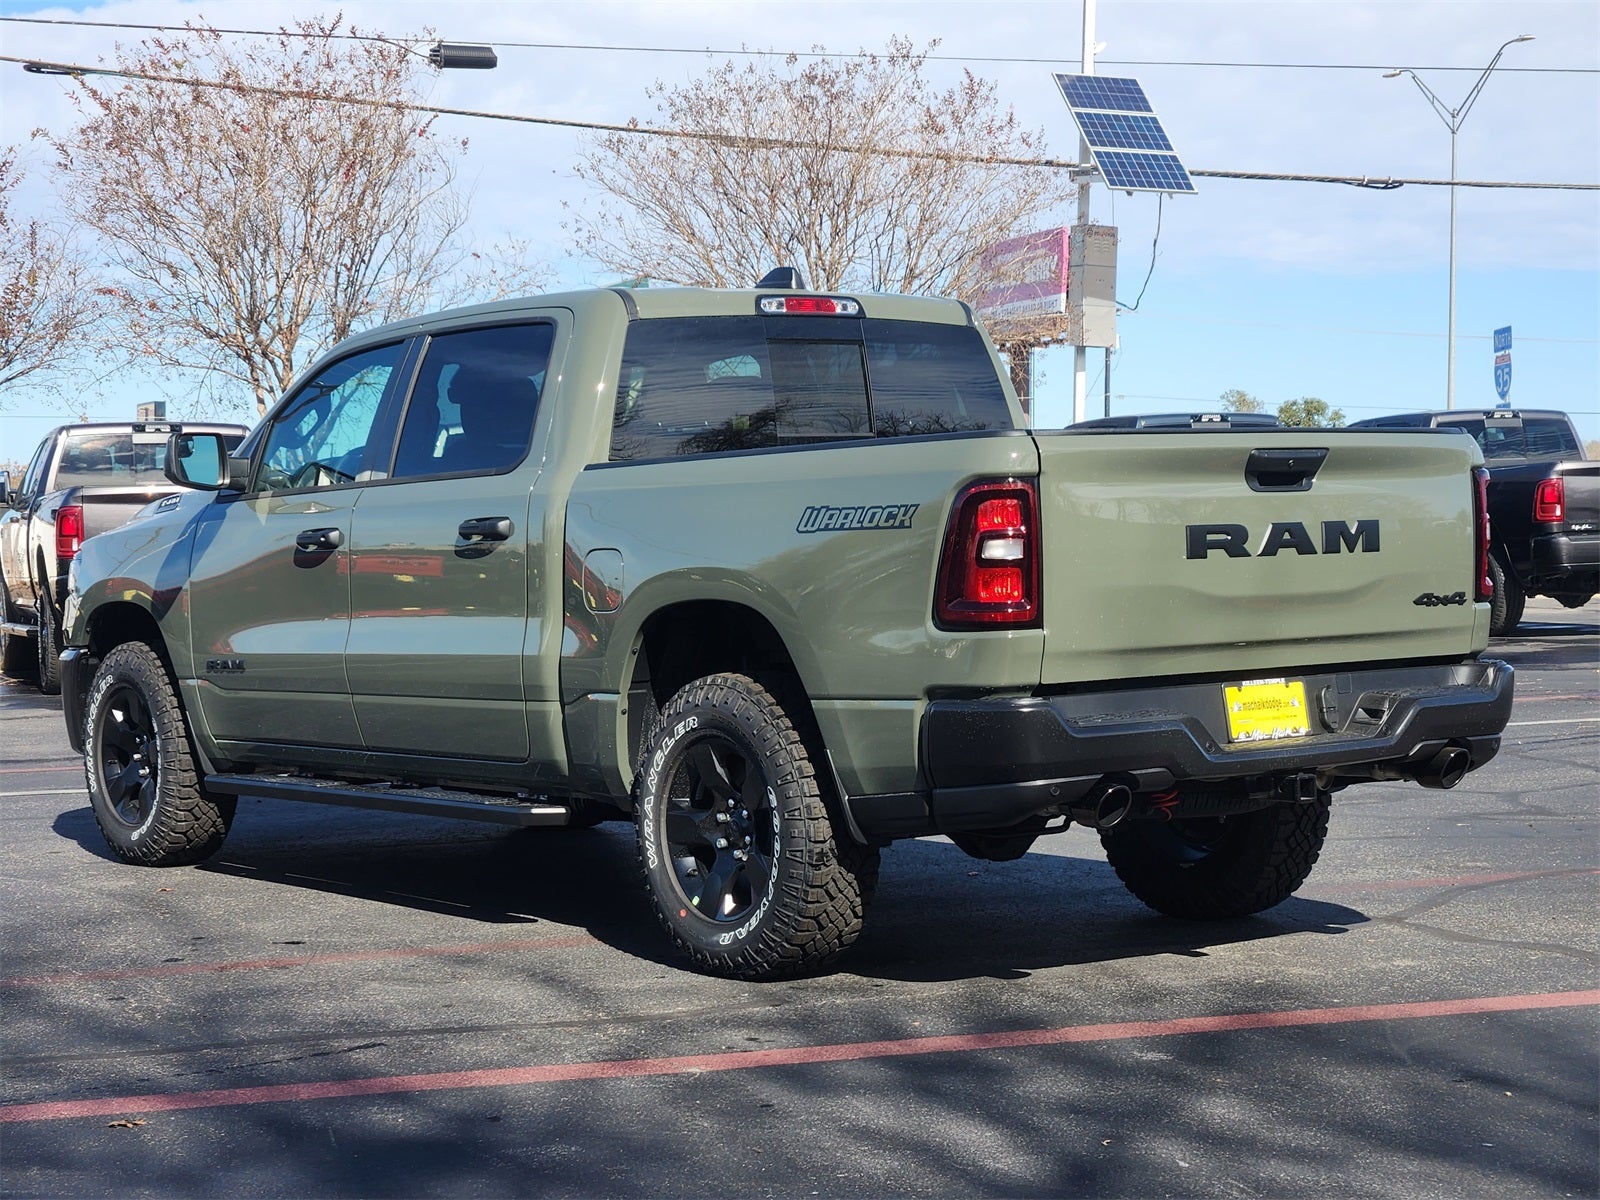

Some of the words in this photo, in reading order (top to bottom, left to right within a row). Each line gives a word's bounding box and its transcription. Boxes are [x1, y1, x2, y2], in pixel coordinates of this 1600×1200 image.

[1495, 332, 1511, 348] NORTH
[1496, 368, 1510, 393] 35
[796, 504, 920, 534] WARLOCK
[1186, 519, 1380, 559] RAM
[1412, 591, 1468, 607] 4x4
[206, 659, 246, 674] RAM
[85, 674, 113, 793] WRANGLER
[643, 716, 699, 869] WRANGLER
[719, 785, 782, 945] GOODYEAR
